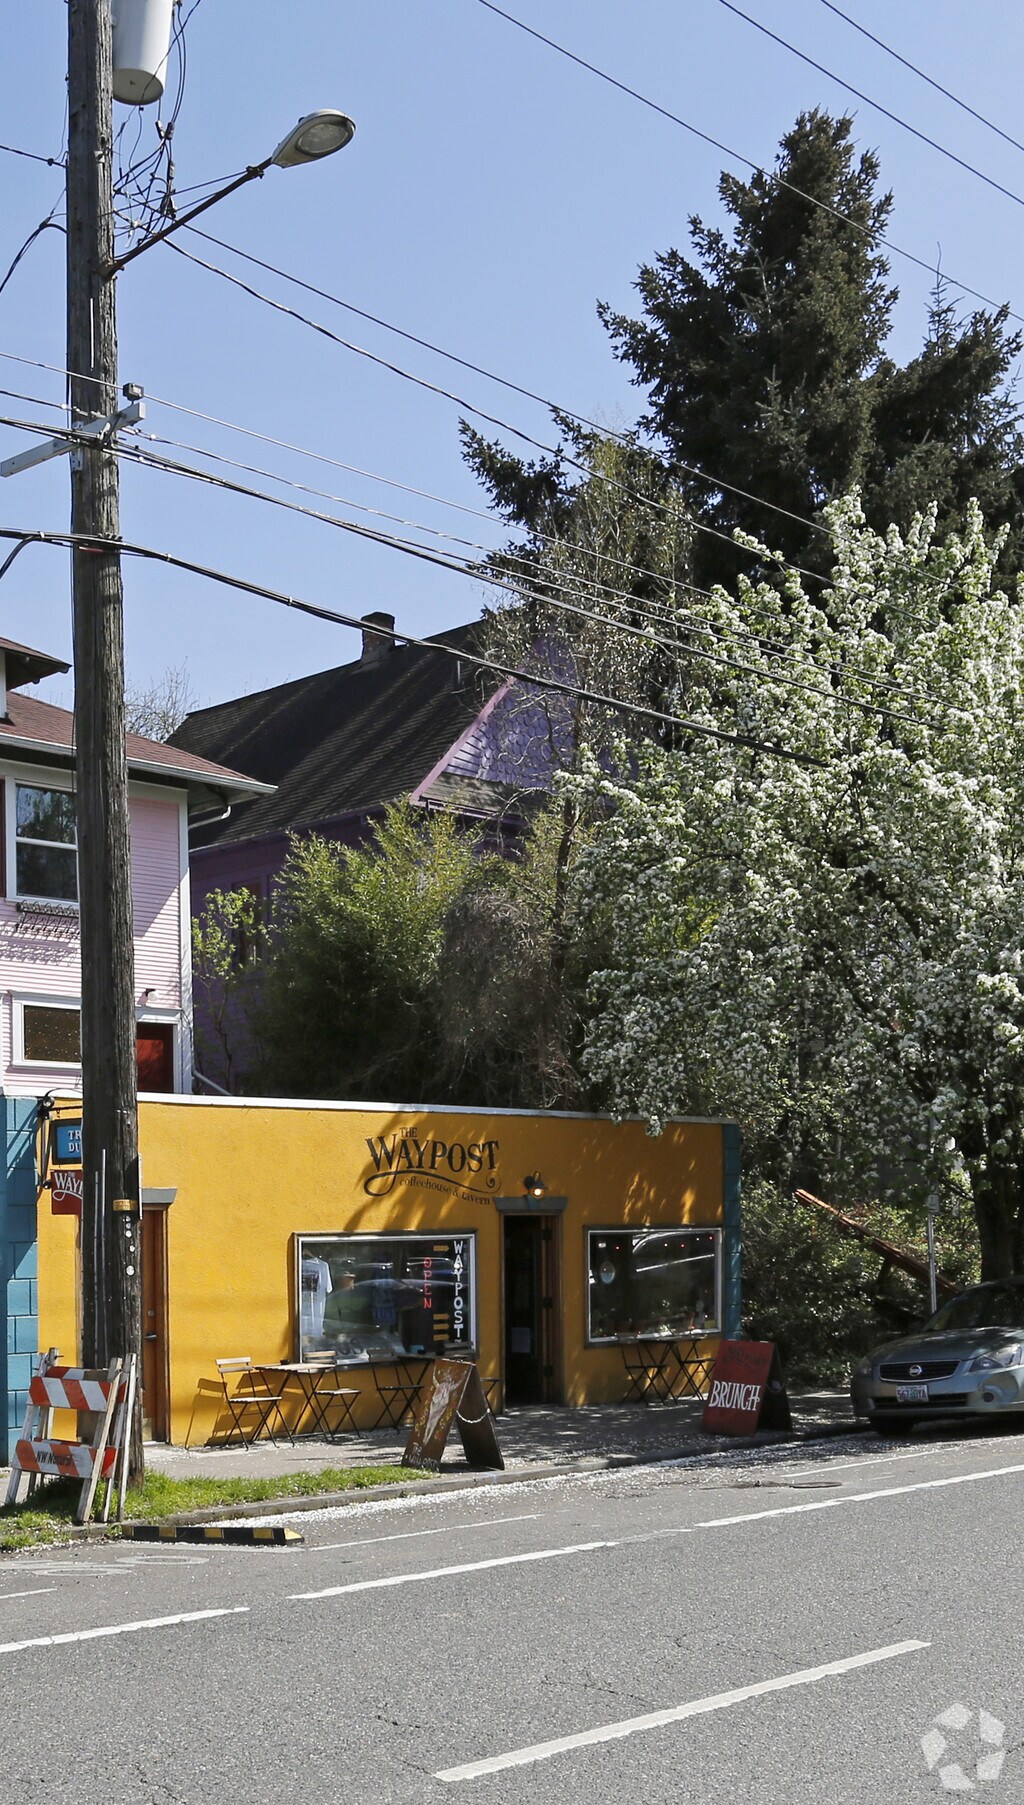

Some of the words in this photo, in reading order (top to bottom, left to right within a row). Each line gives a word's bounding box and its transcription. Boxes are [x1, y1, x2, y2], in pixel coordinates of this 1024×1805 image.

[399, 1127, 418, 1138] THE
[365, 1133, 500, 1174] WAYPOST
[399, 1176, 451, 1195] coffeehouse
[461, 1191, 491, 1206] tavern
[423, 1257, 432, 1309] OPEN
[454, 1241, 463, 1338] WAYPOST
[709, 1381, 761, 1411] BRUNCH
